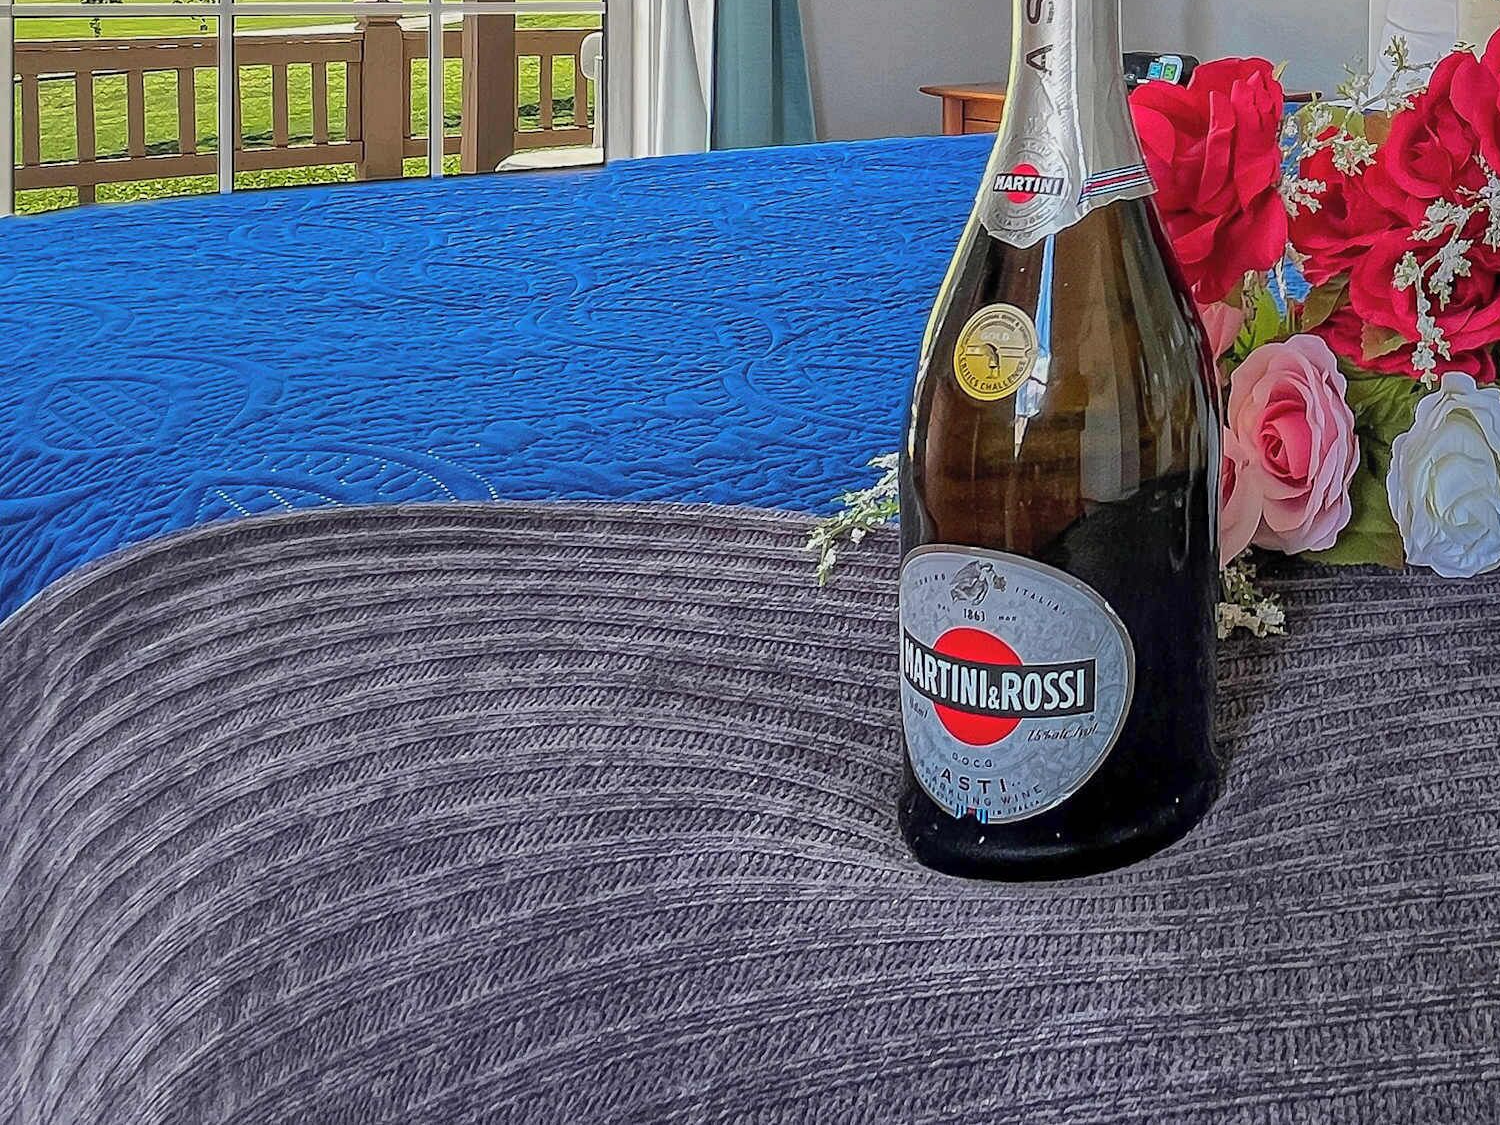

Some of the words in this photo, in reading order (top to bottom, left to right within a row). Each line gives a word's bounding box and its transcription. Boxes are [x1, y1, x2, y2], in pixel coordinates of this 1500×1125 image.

[994, 175, 1060, 195] MARTINI
[959, 357, 980, 388] CRITICS
[980, 360, 1027, 391] CHALLENGE
[1015, 586, 1060, 612] ITALIA
[940, 767, 1009, 795] ASTI
[1001, 783, 1042, 805] WINE
